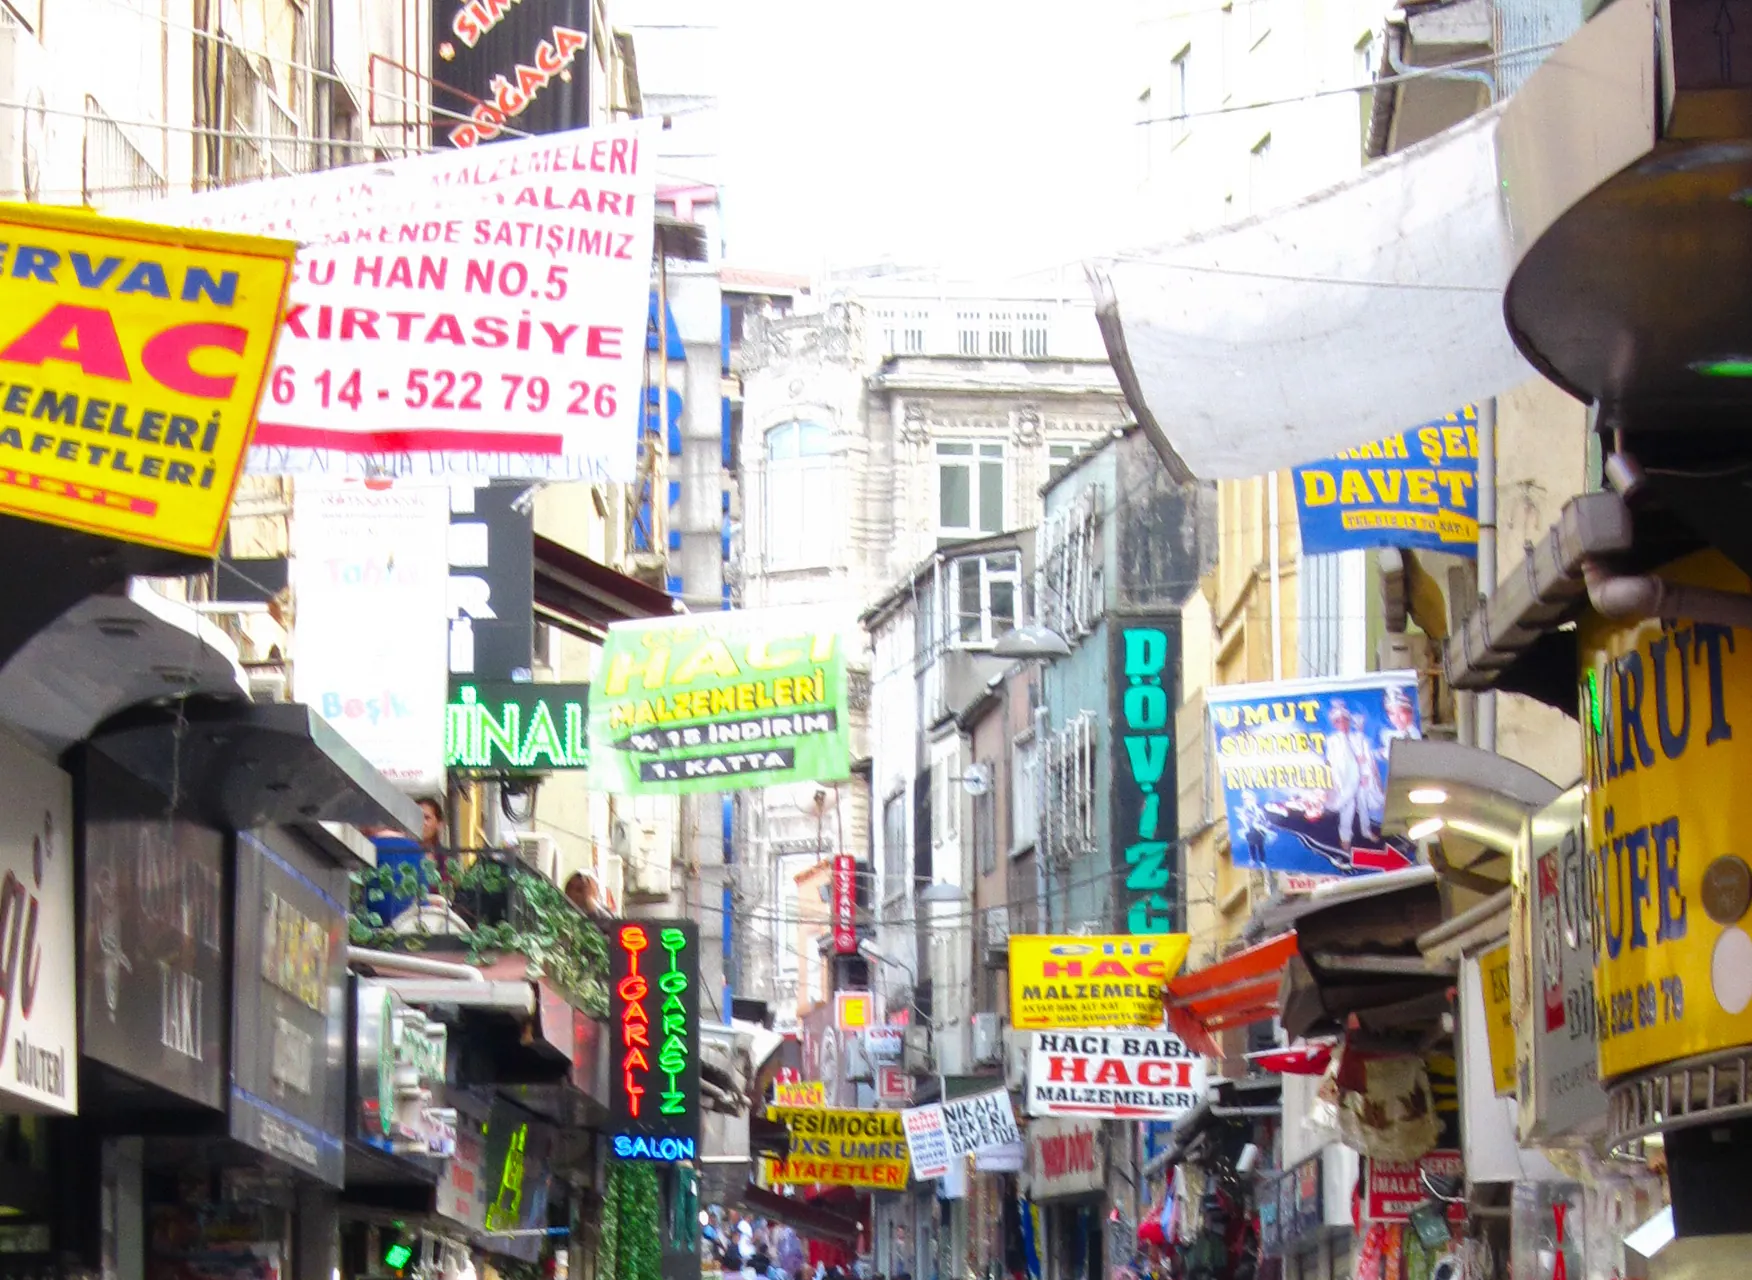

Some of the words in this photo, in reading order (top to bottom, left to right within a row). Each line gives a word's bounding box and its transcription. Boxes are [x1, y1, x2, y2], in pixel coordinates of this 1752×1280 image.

[473, 219, 635, 262] SATIŞIMIZ
[353, 254, 449, 292] HAN
[464, 256, 569, 301] NO.5
[283, 303, 624, 361] KIRTASİYE
[314, 368, 363, 412] 14
[404, 368, 484, 412] 522
[500, 372, 551, 413] 79
[566, 379, 618, 418] 26
[0, 380, 221, 455] EMELERİ
[610, 668, 825, 730] MALZEMELERİ
[1216, 699, 1321, 729] UMUT
[708, 713, 829, 744] İNDİRİM
[1219, 730, 1327, 758] SÜNNET
[685, 750, 787, 777] KATTA
[1040, 1033, 1110, 1053] HACI
[1047, 1056, 1194, 1089] HACI
[613, 1134, 696, 1161] SALON
[840, 1139, 907, 1160] UMRE
